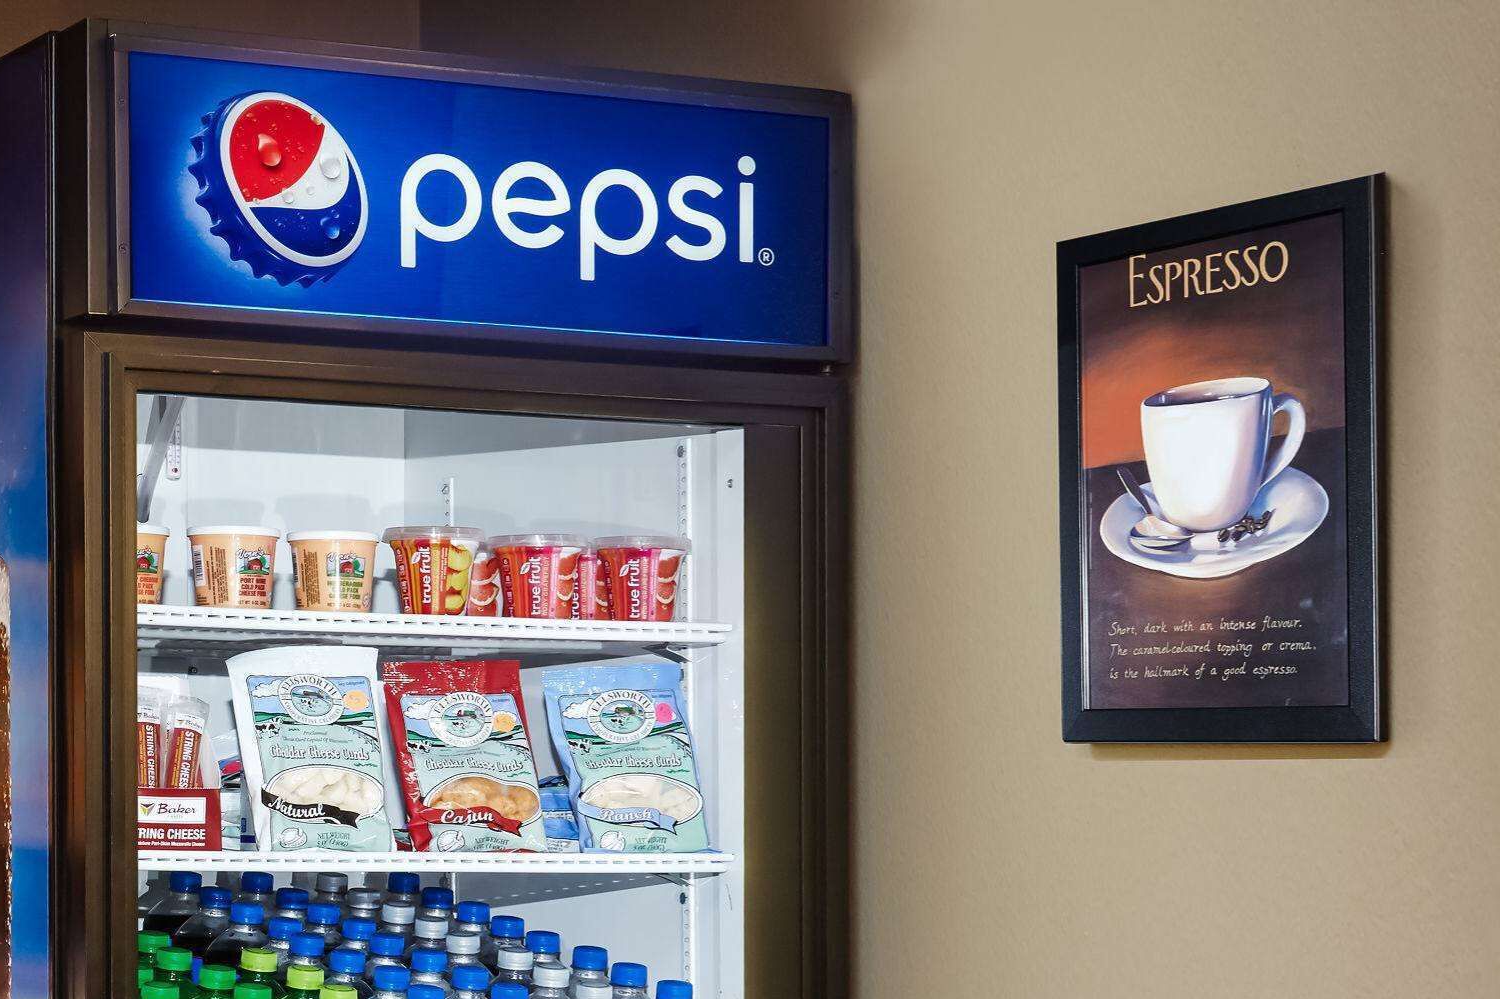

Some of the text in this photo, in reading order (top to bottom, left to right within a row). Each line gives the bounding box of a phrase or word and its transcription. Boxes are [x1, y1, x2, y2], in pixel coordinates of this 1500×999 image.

[400, 153, 756, 281] pepsi
[1143, 620, 1168, 633] dark
[1173, 619, 1195, 632] with
[1199, 621, 1214, 631] an
[1219, 617, 1256, 631] intense
[1217, 639, 1253, 657] topping
[1262, 642, 1273, 651] or
[1109, 667, 1119, 679] is
[1124, 666, 1138, 679] the
[1144, 664, 1190, 678] hallmark
[1195, 662, 1206, 680] of
[1210, 666, 1218, 675] a
[1223, 662, 1247, 681] good
[146, 725, 156, 757] STRING
[181, 730, 195, 762] STRING
[269, 744, 306, 758] Cheddar
[308, 746, 341, 759] Cheese
[157, 803, 197, 815] Baker
[268, 798, 326, 818] Natural
[440, 809, 494, 827] Cajun
[167, 828, 206, 840] CHEESE
